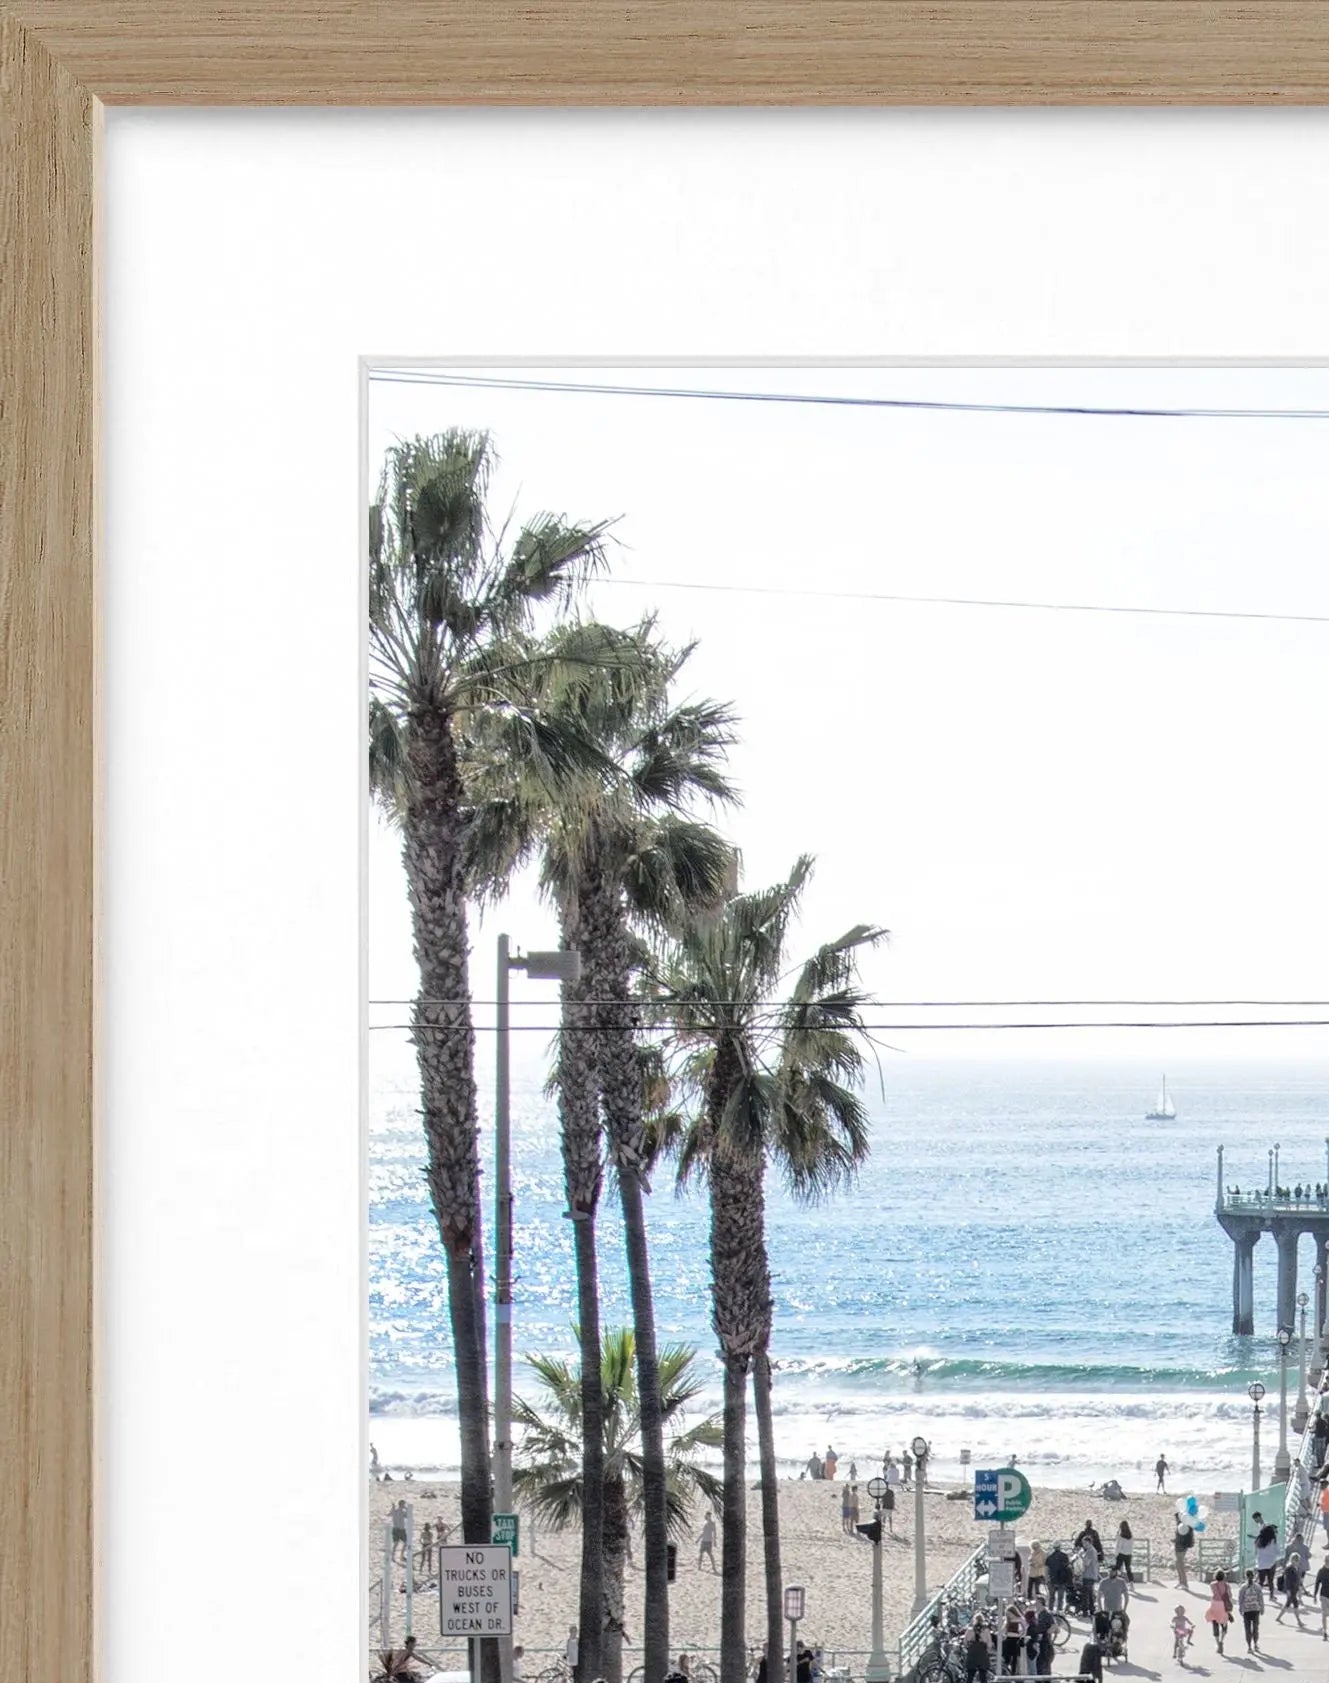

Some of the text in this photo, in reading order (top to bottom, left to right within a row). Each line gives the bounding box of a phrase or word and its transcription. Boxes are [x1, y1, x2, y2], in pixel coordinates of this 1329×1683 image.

[997, 1474, 1022, 1511] P
[466, 1552, 484, 1564] NO
[445, 1569, 506, 1581] TRUCKS OR
[458, 1586, 493, 1597] BUSES
[453, 1602, 499, 1614] WEST OF
[447, 1618, 506, 1630] OCEAN DR.
